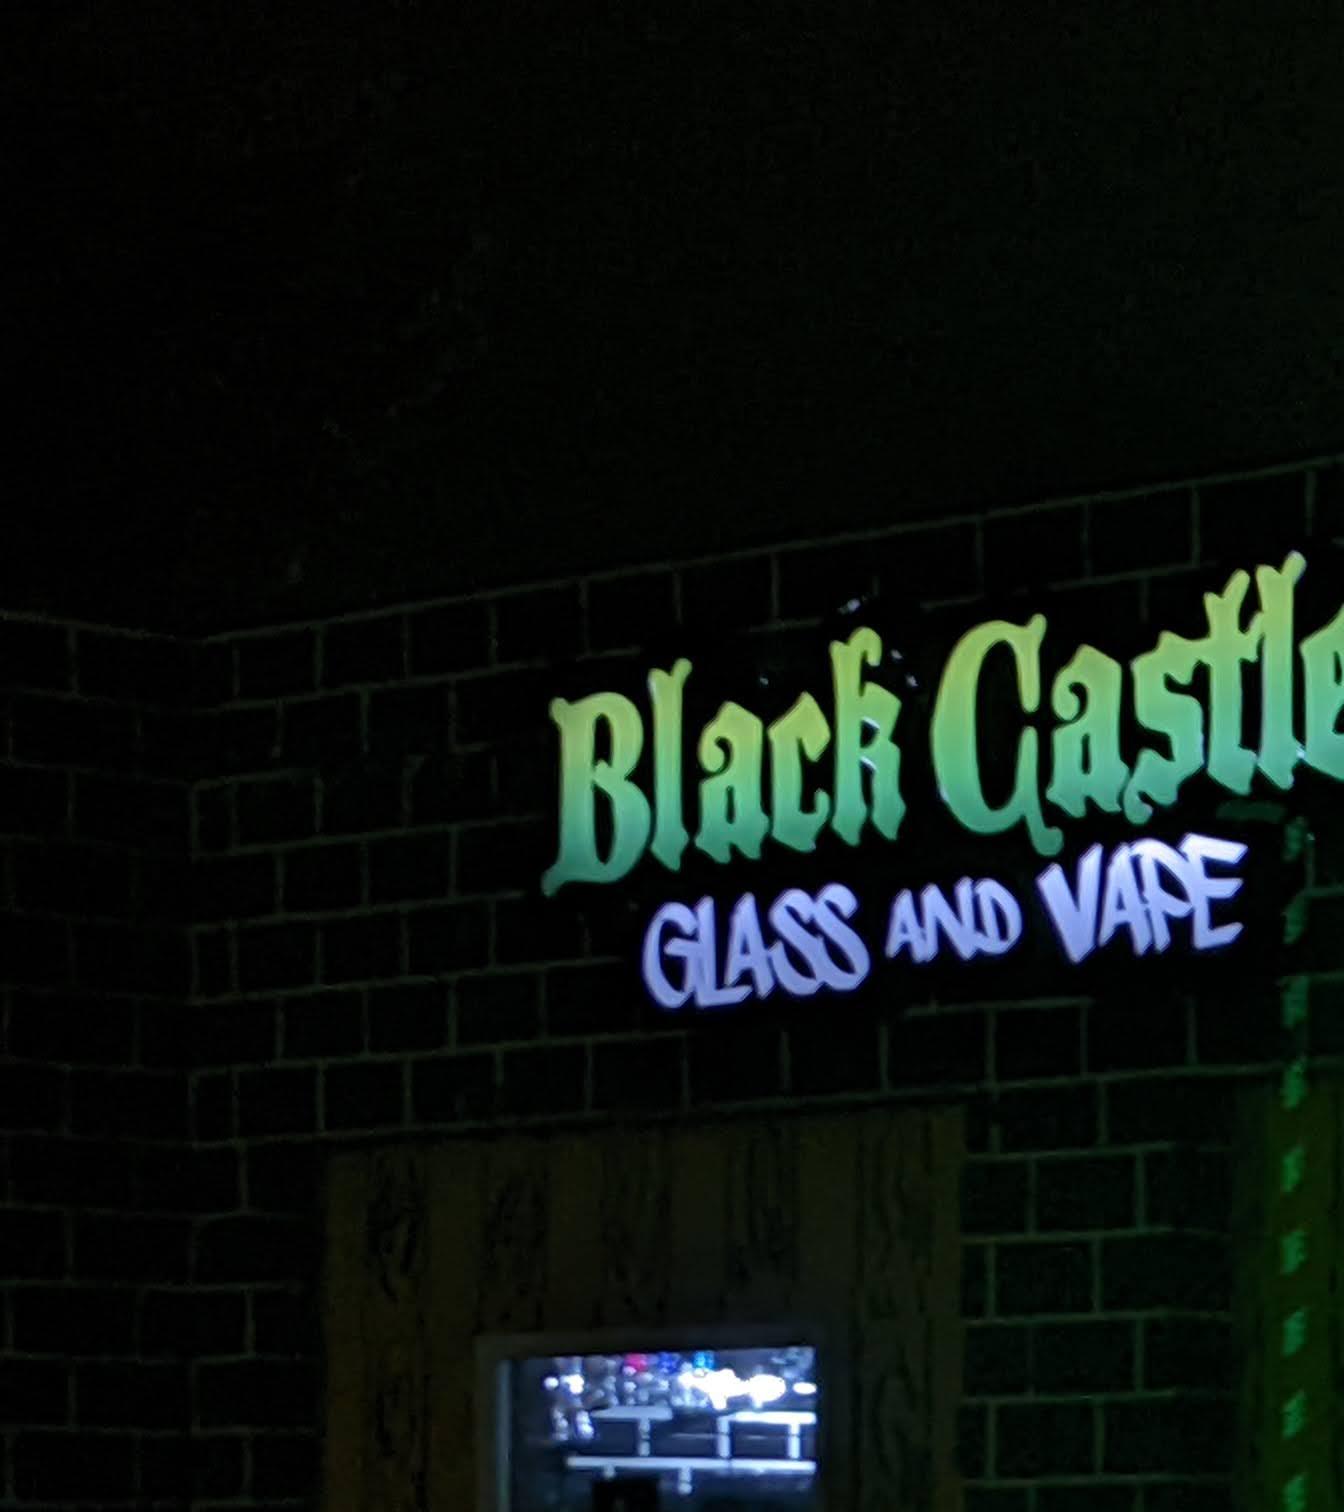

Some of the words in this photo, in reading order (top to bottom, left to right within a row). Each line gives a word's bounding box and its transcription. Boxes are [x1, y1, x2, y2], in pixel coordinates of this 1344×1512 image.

[542, 626, 907, 899] Black
[641, 881, 872, 1011] GLASS
[884, 876, 1023, 965] AND
[1036, 832, 1249, 967] VAPE
